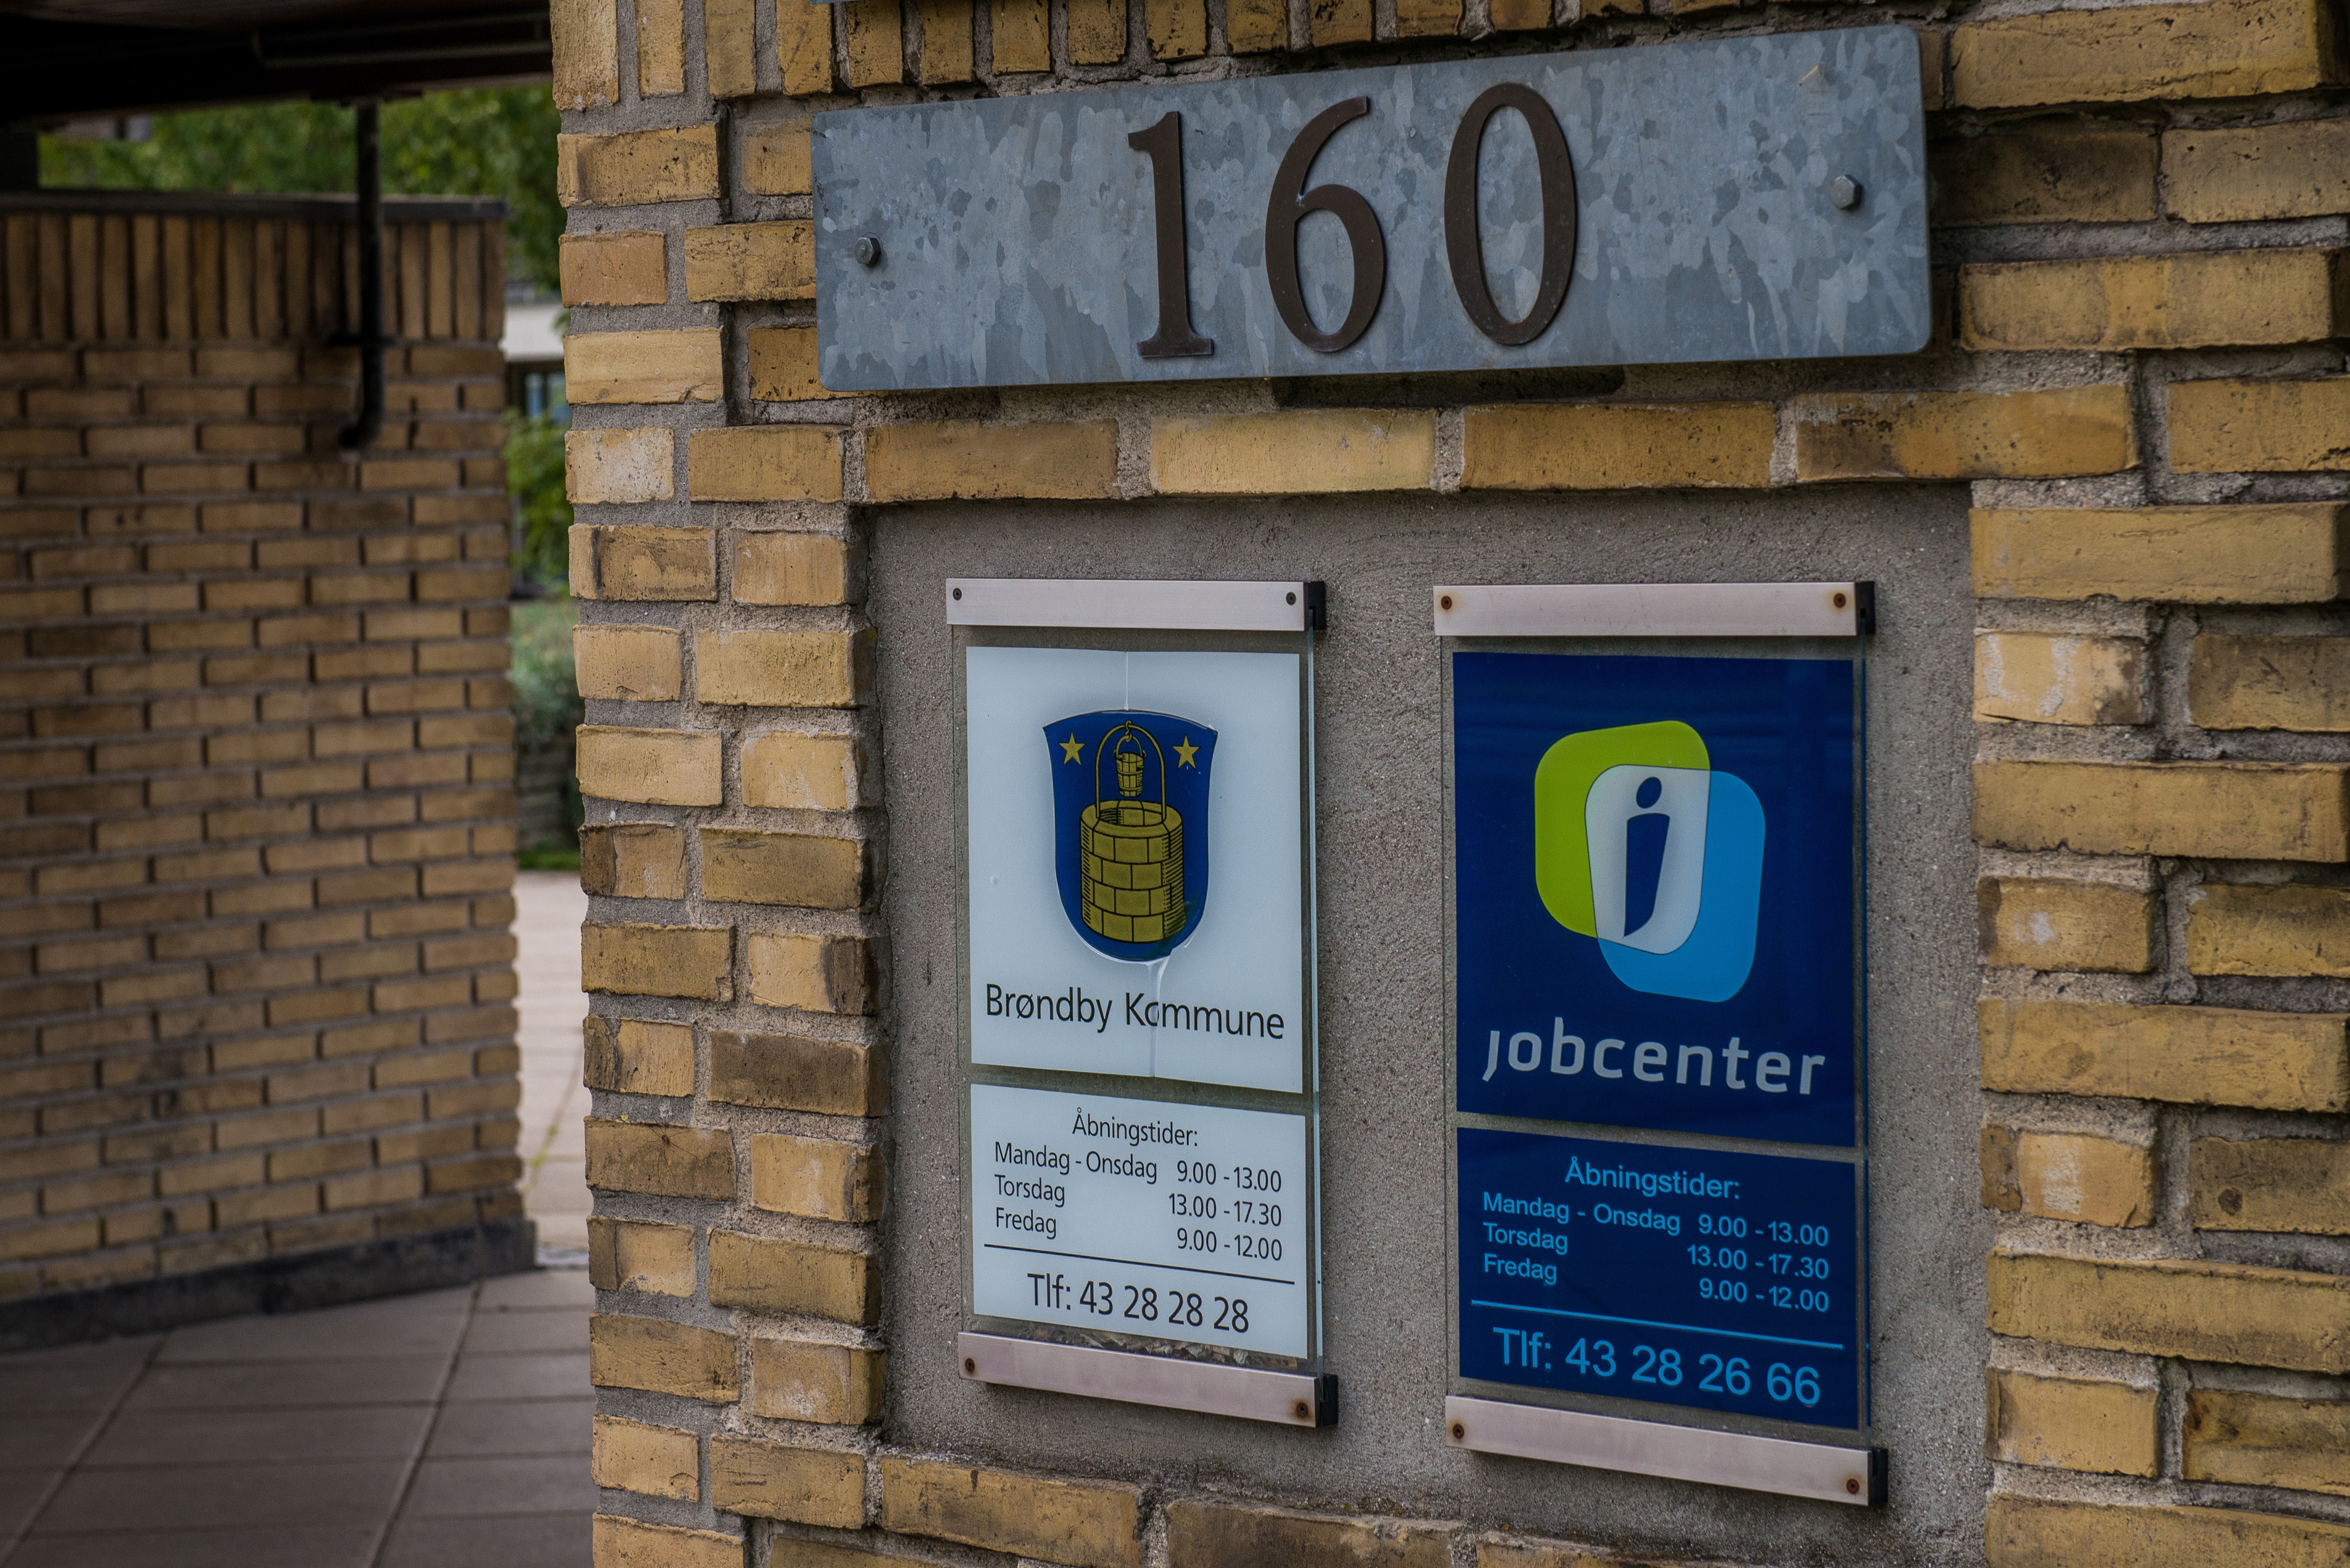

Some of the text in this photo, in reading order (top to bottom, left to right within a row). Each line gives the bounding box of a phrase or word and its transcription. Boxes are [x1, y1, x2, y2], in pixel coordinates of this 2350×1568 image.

[1126, 82, 1577, 360] 160
[986, 983, 1284, 1040] Brøndby Kommune
[1482, 1016, 1826, 1094] jobcenter
[1072, 1107, 1198, 1147] Åbningstider:
[995, 1141, 1070, 1176] Mandag
[1086, 1150, 1157, 1185] Onsdag
[1177, 1160, 1217, 1185] 9.00
[1565, 1156, 1740, 1200] Åbningstider:
[994, 1174, 1065, 1208] Torsdag
[1169, 1193, 1217, 1219] 13.00
[1483, 1191, 1569, 1225] Mandag
[1593, 1203, 1680, 1237] Onsdag
[1698, 1214, 1747, 1238] 9.00
[996, 1207, 1056, 1240] Fredag
[1177, 1227, 1217, 1253] 9.00
[1483, 1221, 1568, 1255] Torsdag
[1687, 1244, 1747, 1270] 13.00
[1483, 1253, 1557, 1286] Fredag
[1699, 1277, 1748, 1303] 9.00
[1027, 1272, 1249, 1334] Tlf: 43 28 28 28
[1493, 1327, 1821, 1405] Tlf: 43 28 26 66
